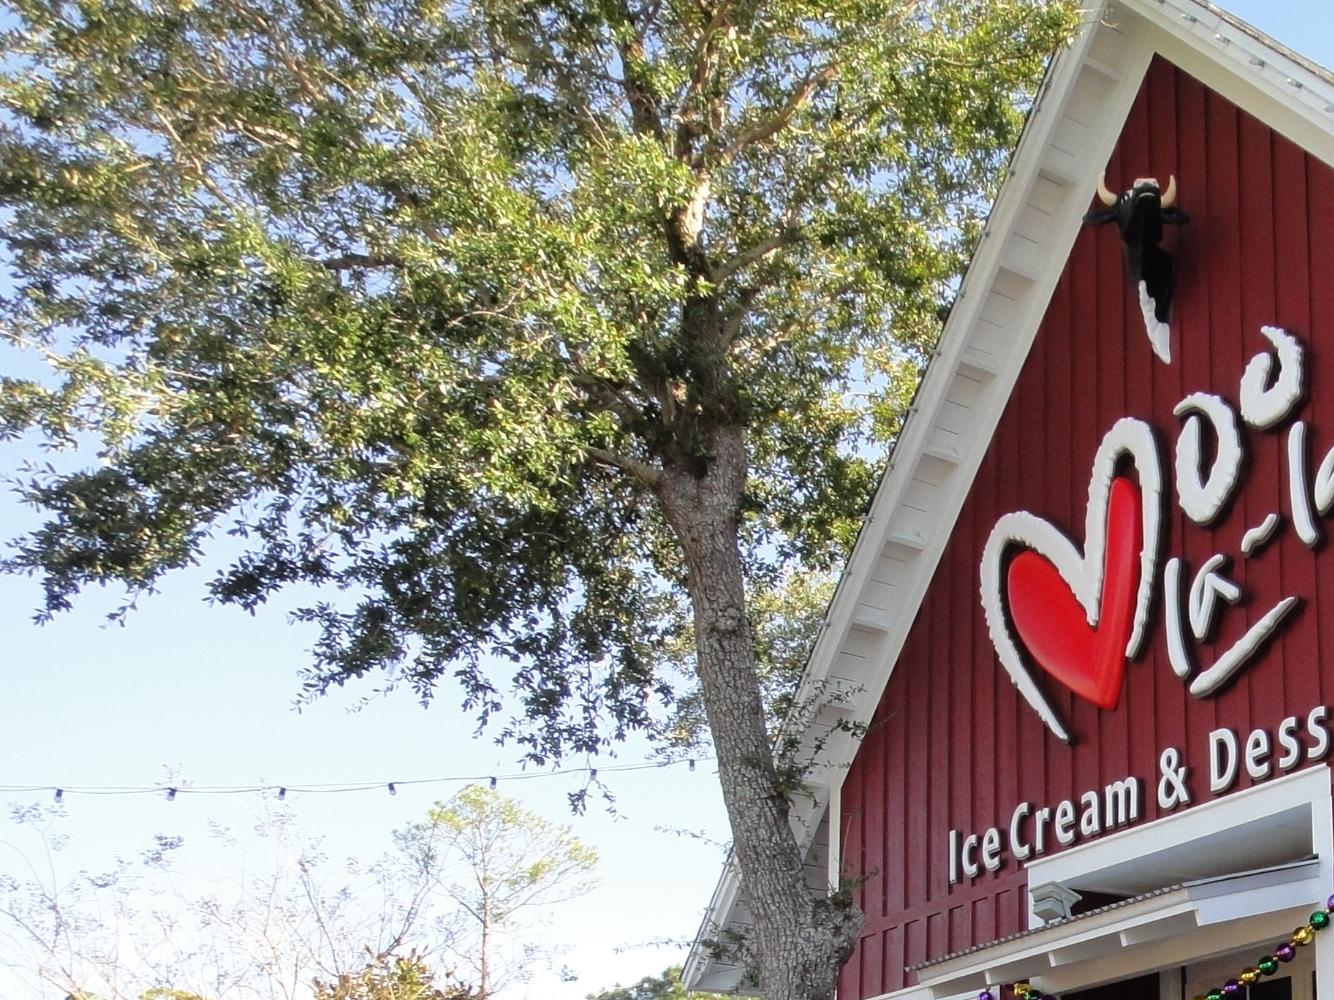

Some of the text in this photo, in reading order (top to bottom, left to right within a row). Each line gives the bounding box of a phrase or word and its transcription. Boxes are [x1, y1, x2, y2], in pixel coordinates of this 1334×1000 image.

[949, 829, 1001, 886] Ice
[1008, 775, 1140, 861] Cream
[1157, 746, 1190, 810] &
